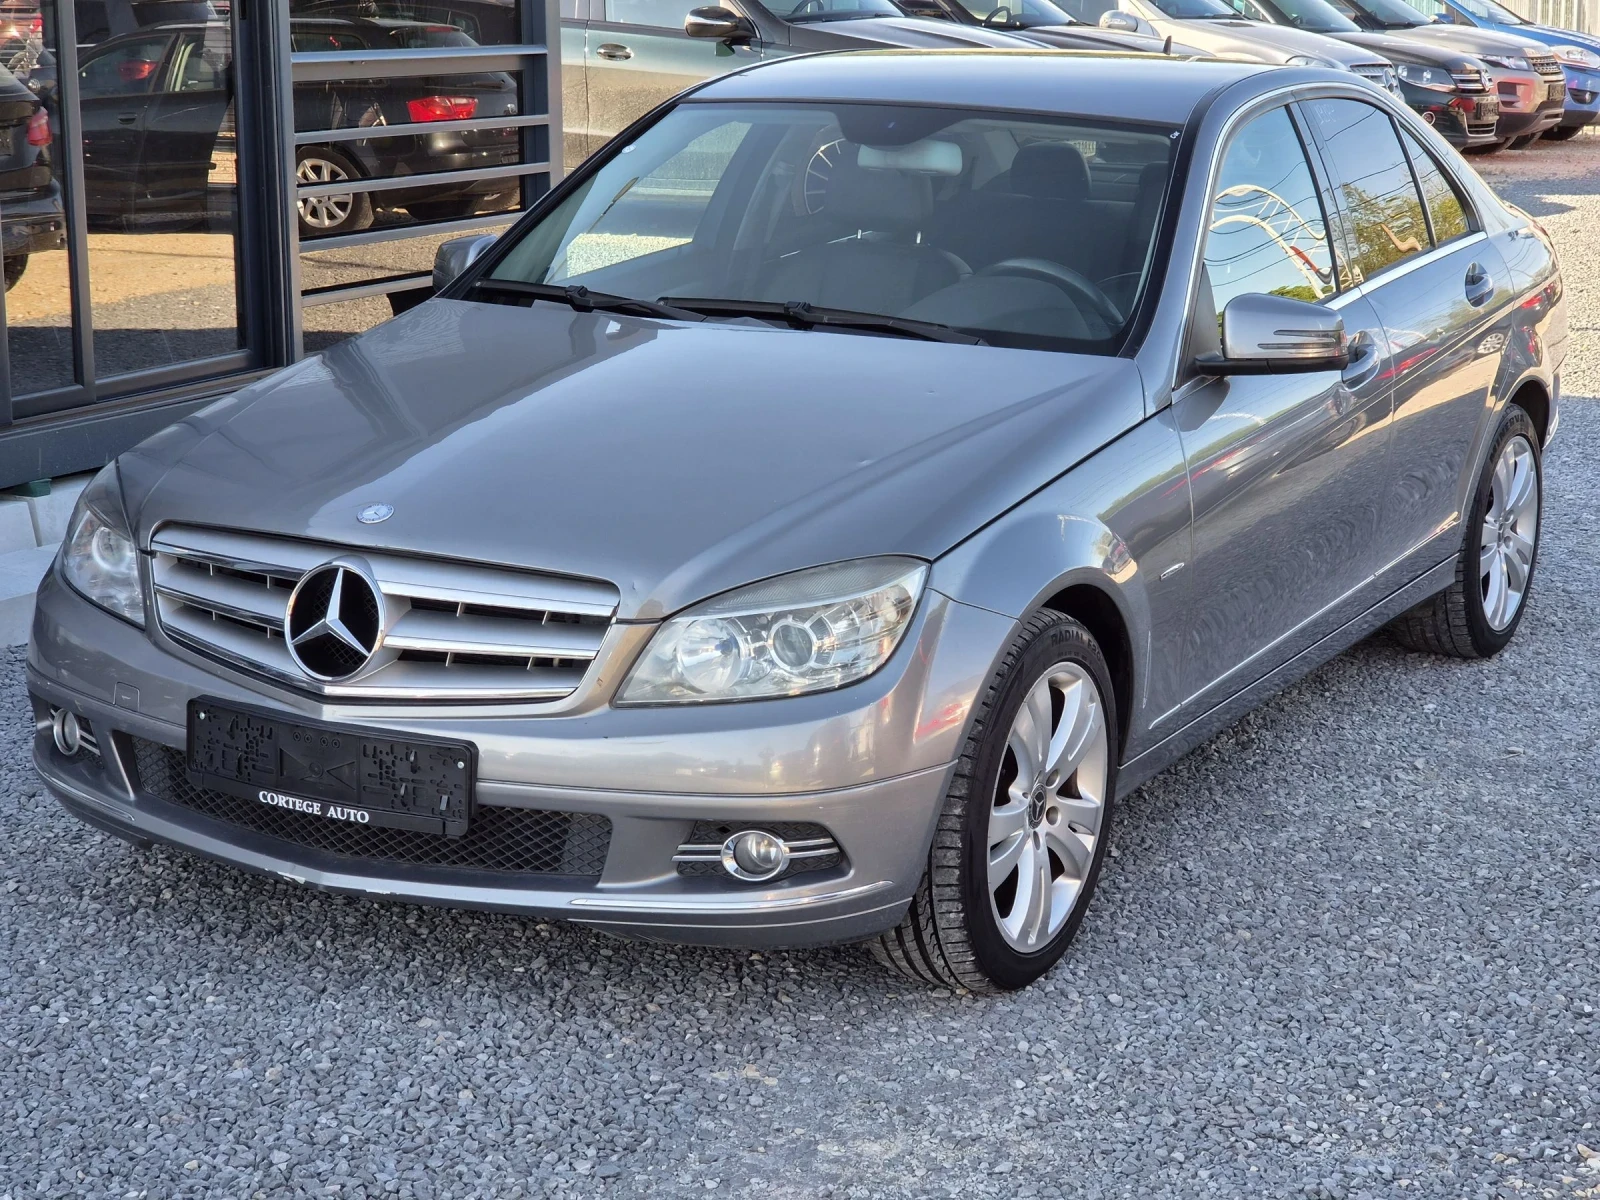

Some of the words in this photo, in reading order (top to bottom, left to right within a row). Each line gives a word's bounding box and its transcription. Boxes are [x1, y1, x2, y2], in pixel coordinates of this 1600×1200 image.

[1489, 413, 1525, 464] MINERVA
[1051, 629, 1085, 647] RADIAL
[258, 790, 322, 815] CORTEGE
[326, 805, 370, 824] AUTO
